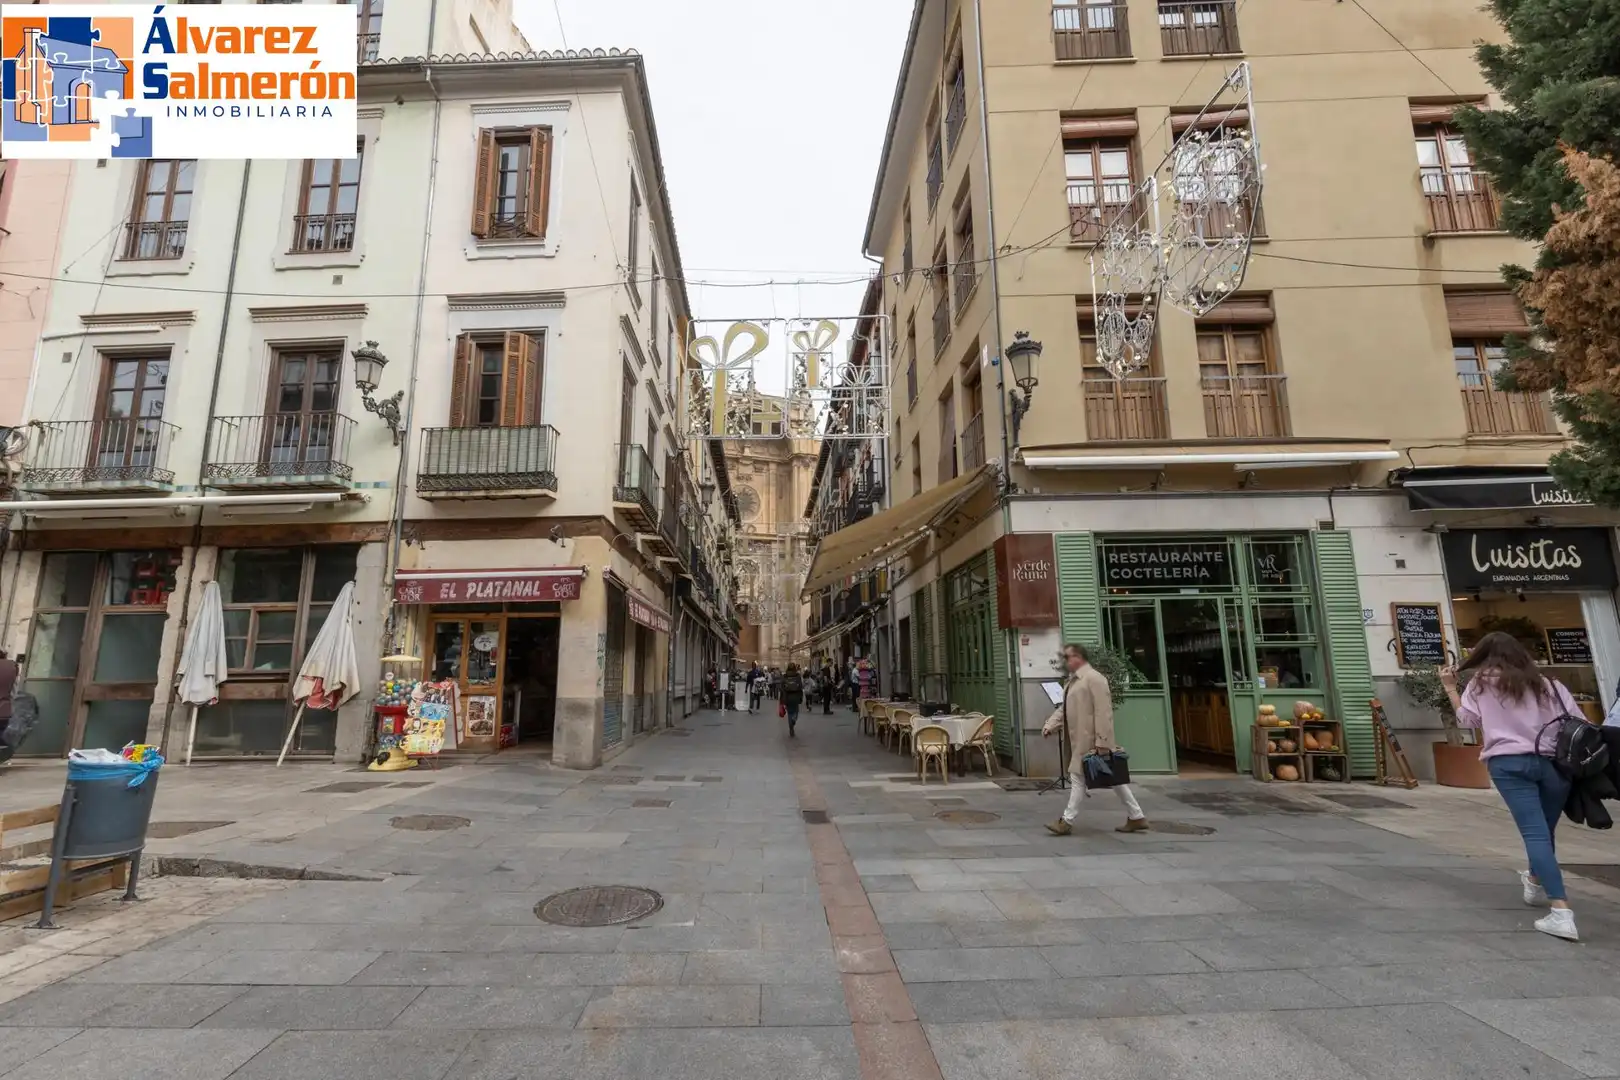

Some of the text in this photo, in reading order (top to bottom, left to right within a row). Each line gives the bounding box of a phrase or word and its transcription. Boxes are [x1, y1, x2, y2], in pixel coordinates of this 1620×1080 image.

[1108, 551, 1224, 564] RESTAURANTE
[1471, 533, 1582, 573] Luisitas
[1110, 565, 1210, 579] COCTELERÍA
[1492, 574, 1530, 582] EMPANADAS
[440, 580, 541, 599] EL PLATANAL
